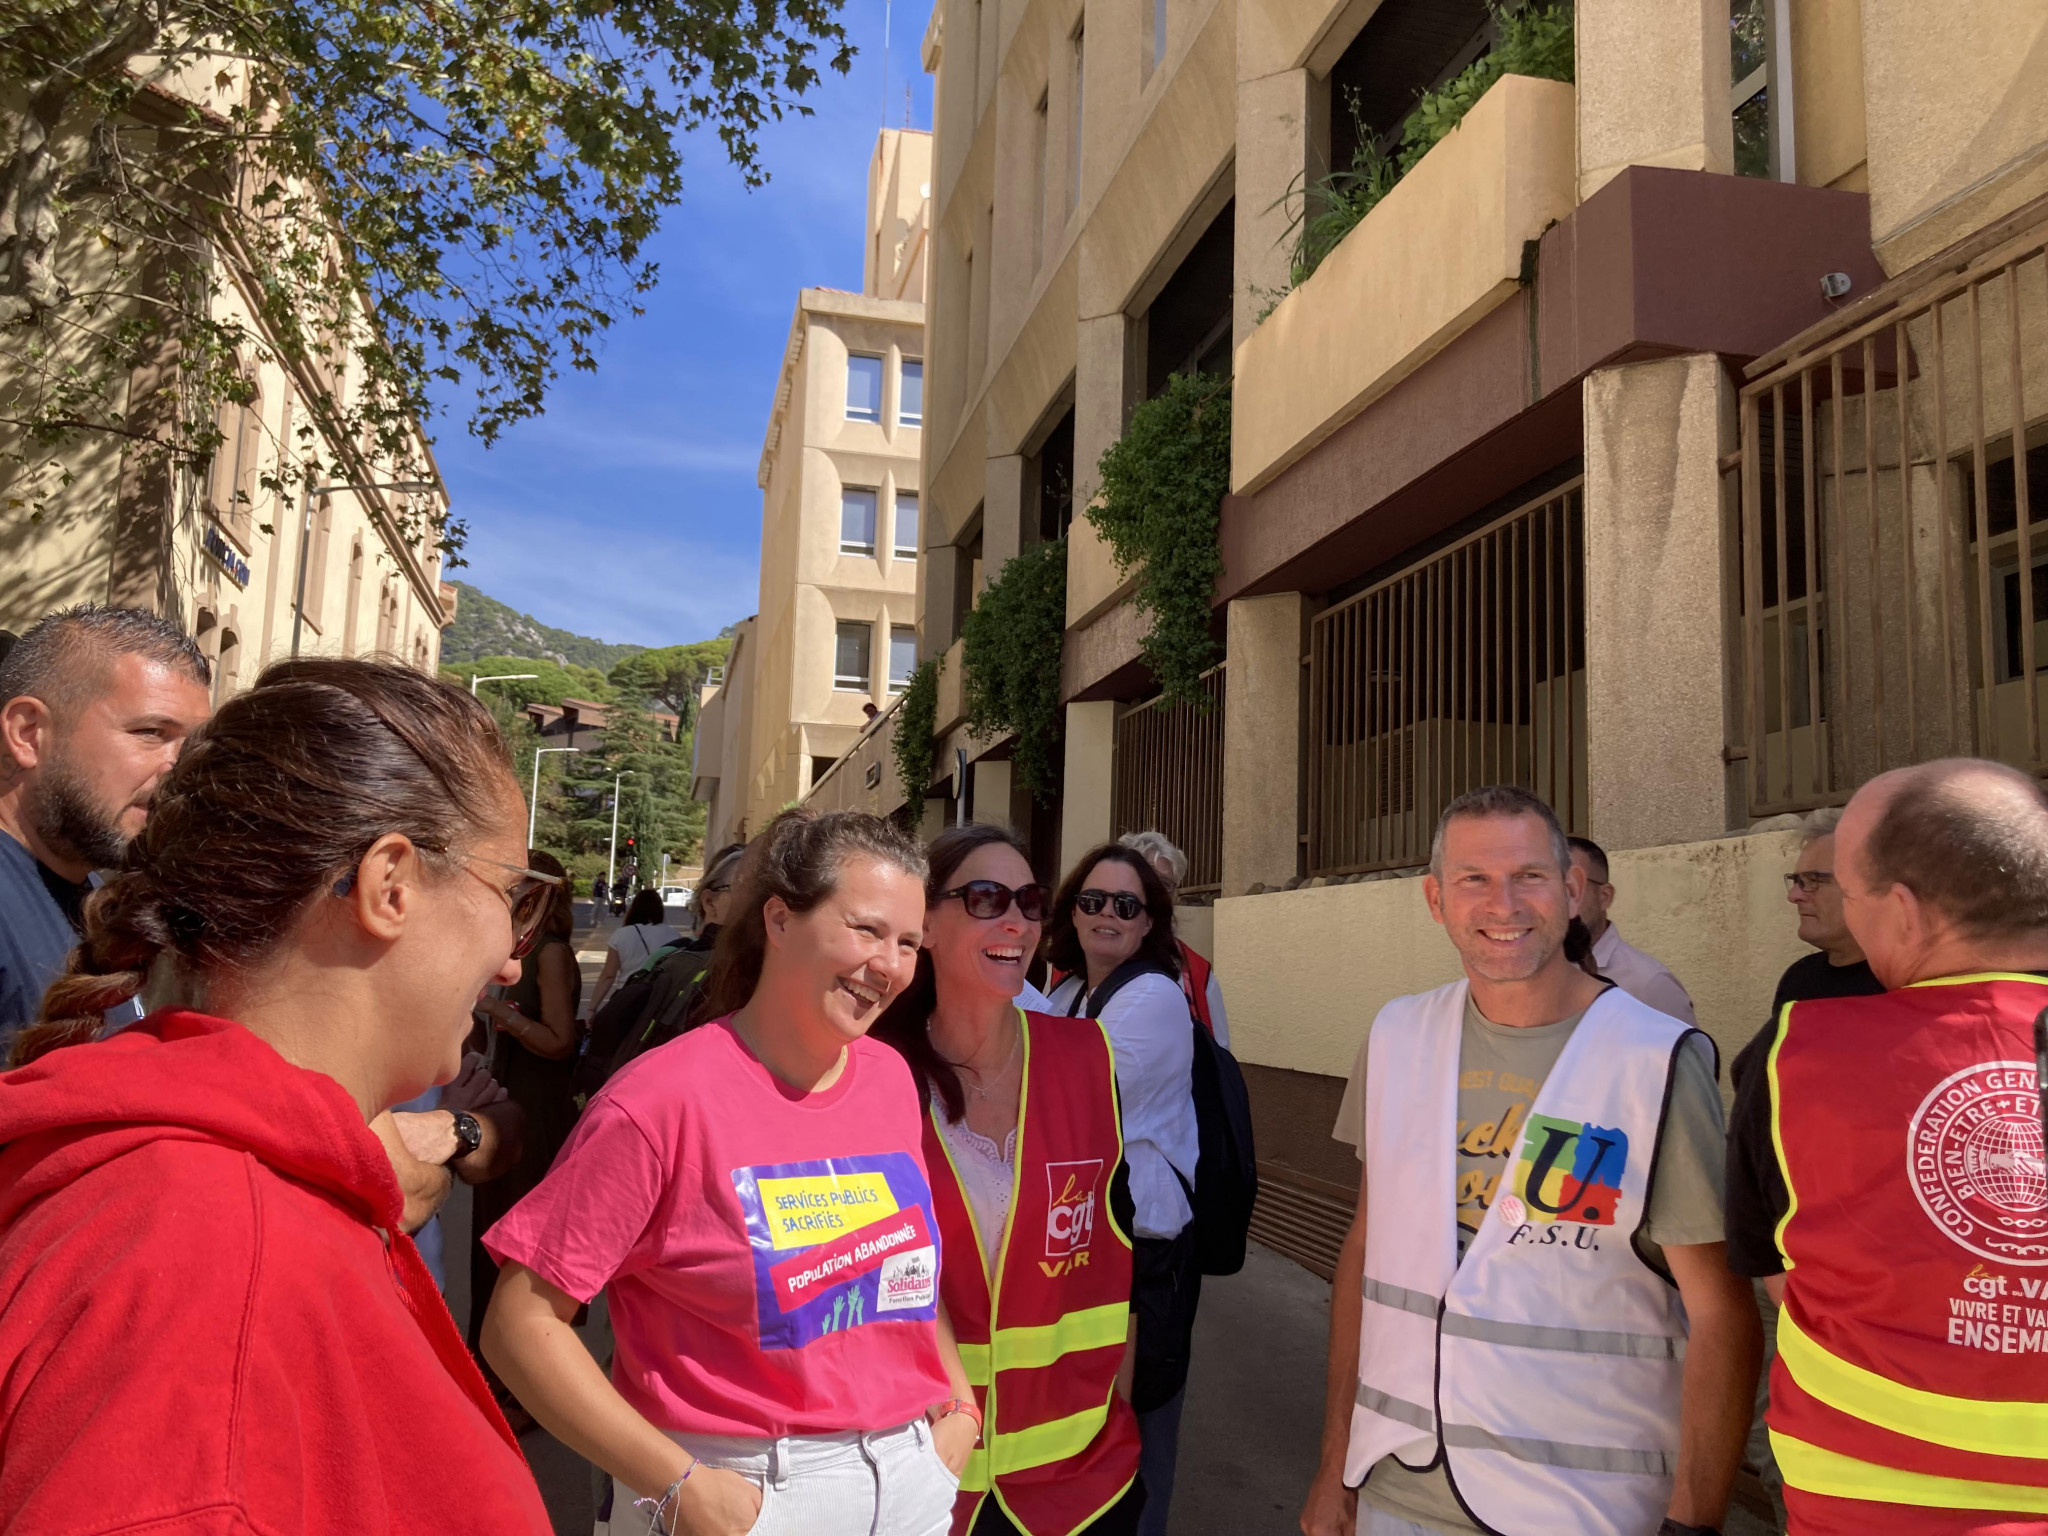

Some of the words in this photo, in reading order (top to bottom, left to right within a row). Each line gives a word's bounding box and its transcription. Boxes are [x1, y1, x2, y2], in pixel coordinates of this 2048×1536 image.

[1917, 1079, 1982, 1237] CONFEDERATION
[1986, 1071, 2036, 1090] GEN
[1944, 1100, 1997, 1201] BIEN-ETRE
[1053, 1173, 1089, 1207] la
[1049, 1191, 1095, 1246] cgt
[1507, 1224, 1600, 1252] F.S.U.
[787, 1251, 853, 1293] POPULATION
[1963, 1275, 2007, 1300] cgt
[1949, 1297, 1998, 1322] VIVRE
[2002, 1304, 2021, 1325] ET
